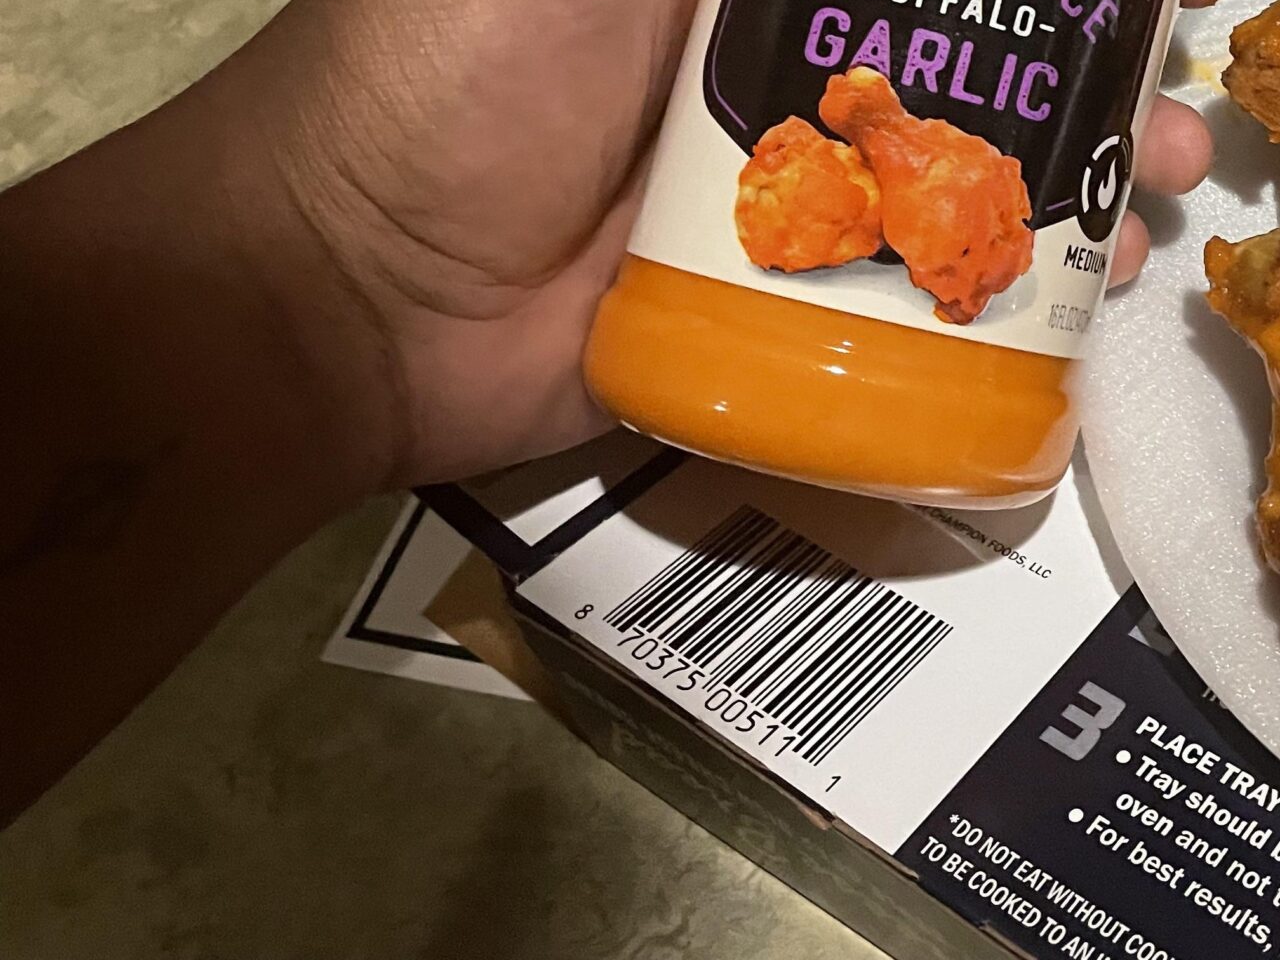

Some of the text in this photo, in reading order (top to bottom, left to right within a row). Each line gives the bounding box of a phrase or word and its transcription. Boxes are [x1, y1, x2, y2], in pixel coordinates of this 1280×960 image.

[803, 6, 1061, 123] GARLIC
[1063, 244, 1108, 277] MEDIUM
[930, 507, 1052, 579] CHAMPION FOODS, LLC
[573, 602, 842, 793] 8 70375 00511 1
[1038, 681, 1127, 761] 3
[1135, 715, 1221, 776] PLACE
[1115, 793, 1175, 837] oven
[1174, 829, 1229, 869] and
[1225, 857, 1272, 897] not
[1134, 755, 1187, 800] Tray
[1184, 795, 1273, 849] should
[919, 836, 1097, 960] TO BE COOKED TO AN
[977, 836, 1021, 871] NOT
[1012, 860, 1053, 893] EAT
[1046, 879, 1131, 945] WITHOUT
[1085, 815, 1131, 853] For
[1127, 841, 1186, 890] best
[1184, 878, 1273, 953] results,
